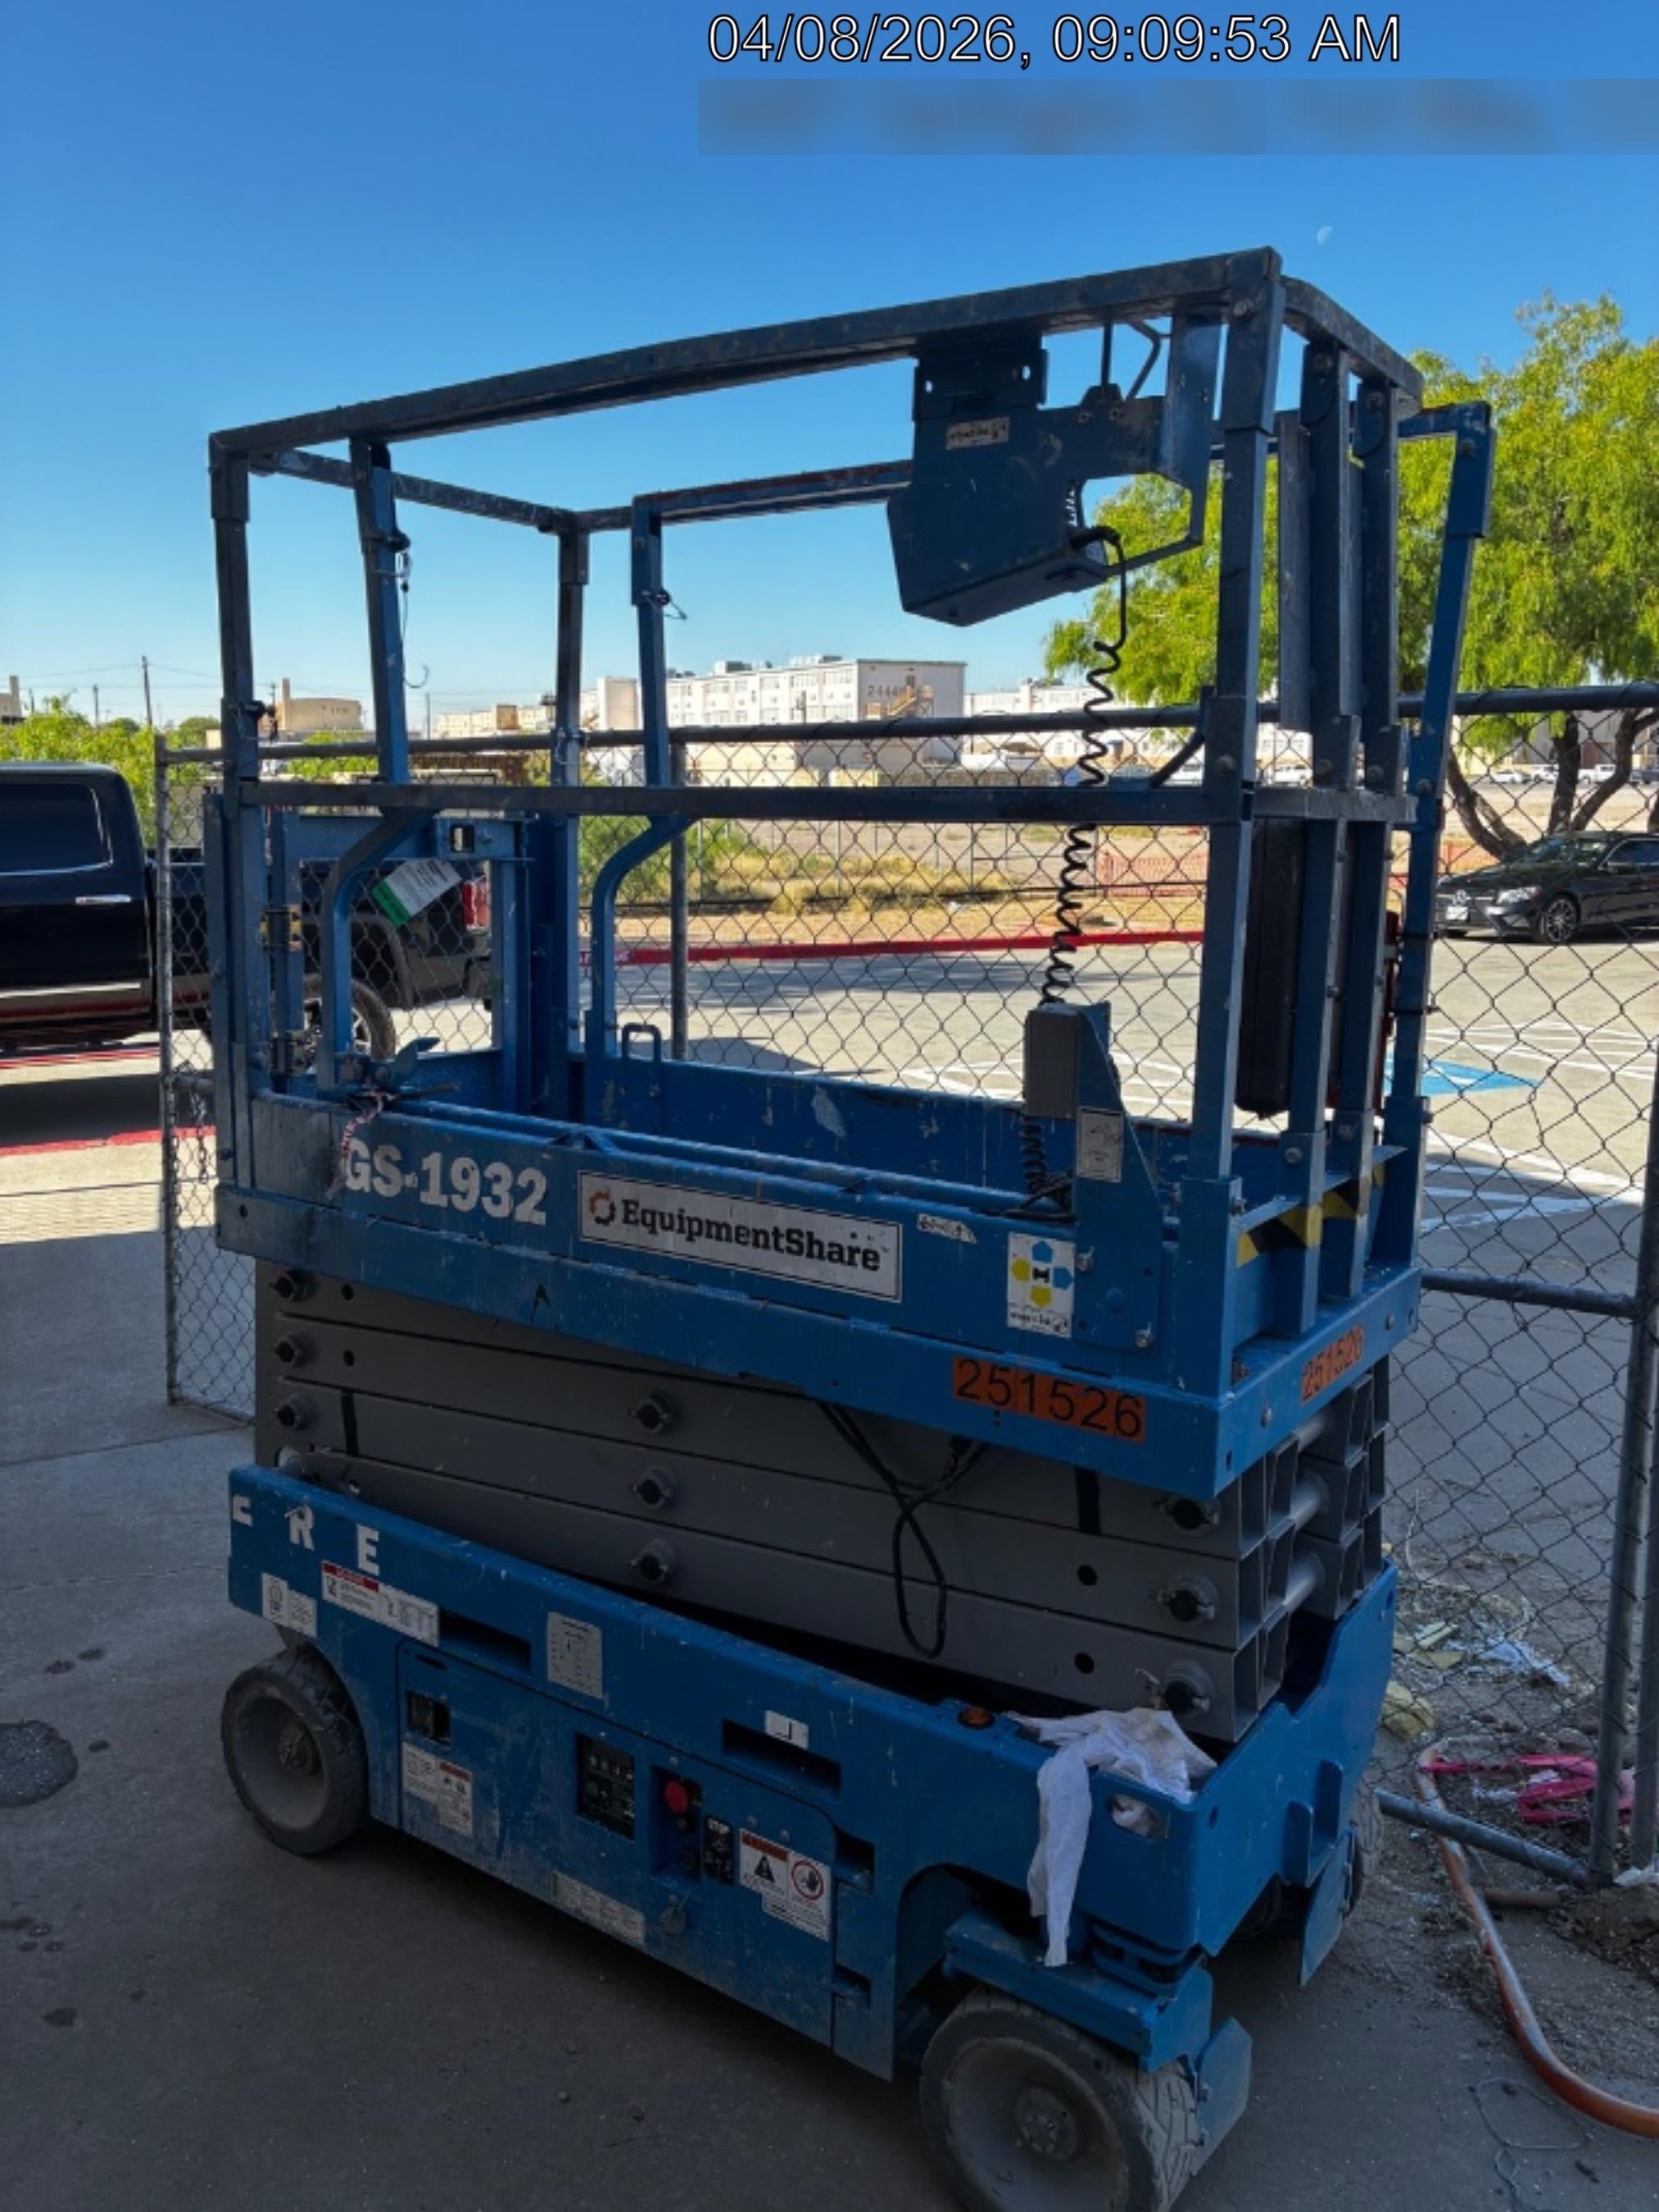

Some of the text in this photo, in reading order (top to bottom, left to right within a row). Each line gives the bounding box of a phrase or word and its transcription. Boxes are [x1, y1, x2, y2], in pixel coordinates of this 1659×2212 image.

[346, 1137, 548, 1226] GS-1932
[621, 1199, 881, 1272] EquipmentShare
[957, 1358, 1142, 1438] 251526
[1300, 1322, 1365, 1402] 251526
